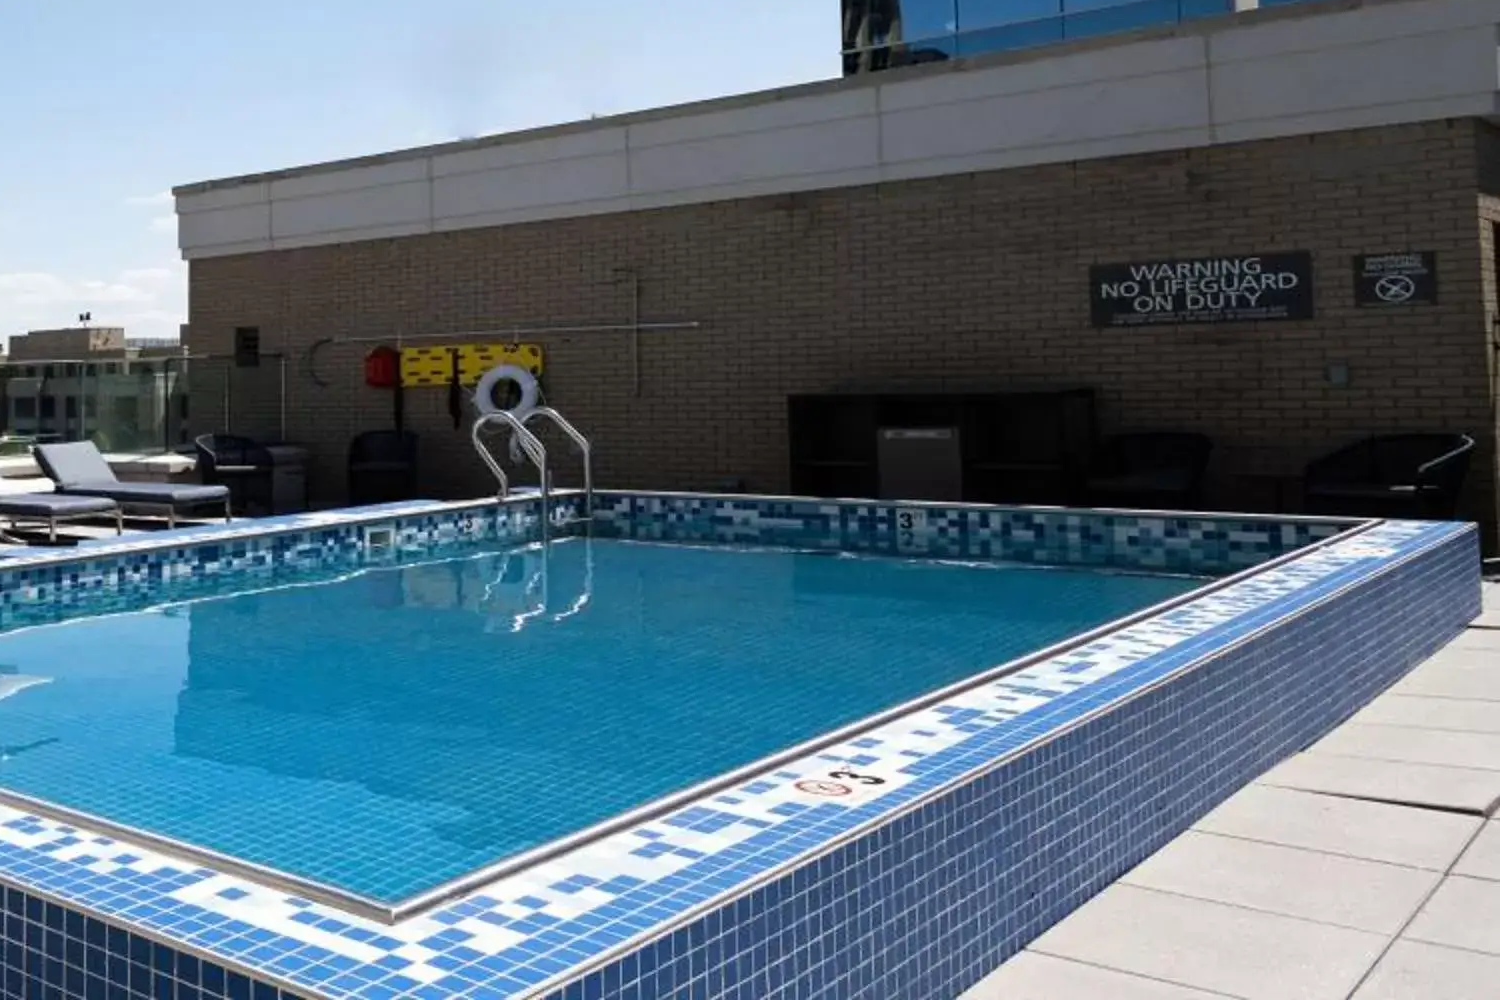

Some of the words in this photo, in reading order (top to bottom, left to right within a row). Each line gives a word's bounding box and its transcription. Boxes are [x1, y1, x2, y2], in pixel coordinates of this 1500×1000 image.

[1130, 257, 1262, 281] WARNING
[1101, 281, 1140, 299] NO
[1151, 272, 1298, 295] LIFEGUARD
[1133, 295, 1173, 313] ON
[1187, 291, 1262, 310] DUTY
[900, 512, 912, 529] 3
